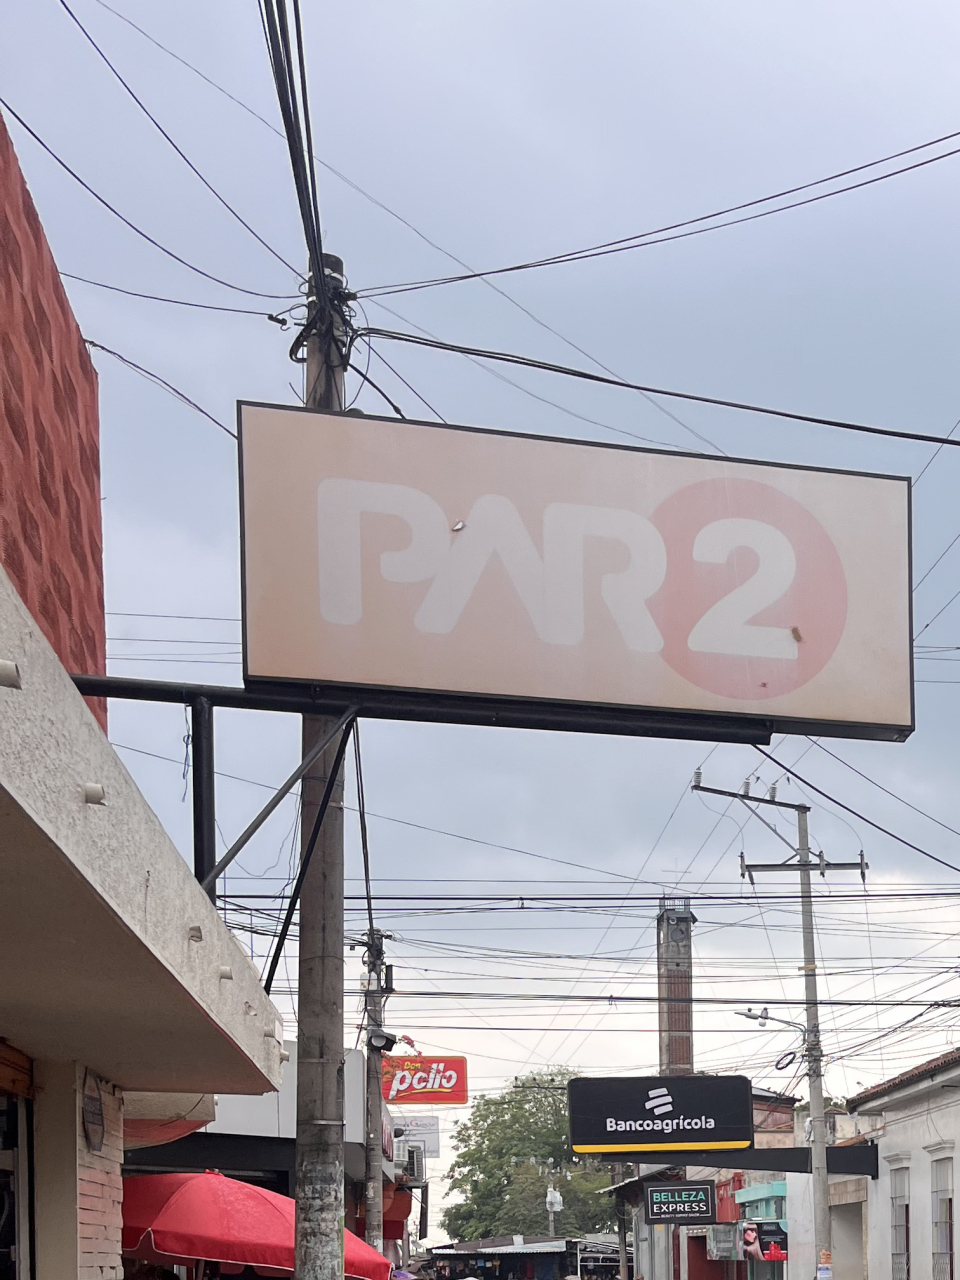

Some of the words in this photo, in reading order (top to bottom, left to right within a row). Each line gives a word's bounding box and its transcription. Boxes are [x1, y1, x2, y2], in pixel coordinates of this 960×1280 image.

[606, 1115, 715, 1134] Bancoagrícola
[653, 1191, 706, 1202] BELLEZA
[653, 1202, 707, 1213] EXPRESS
